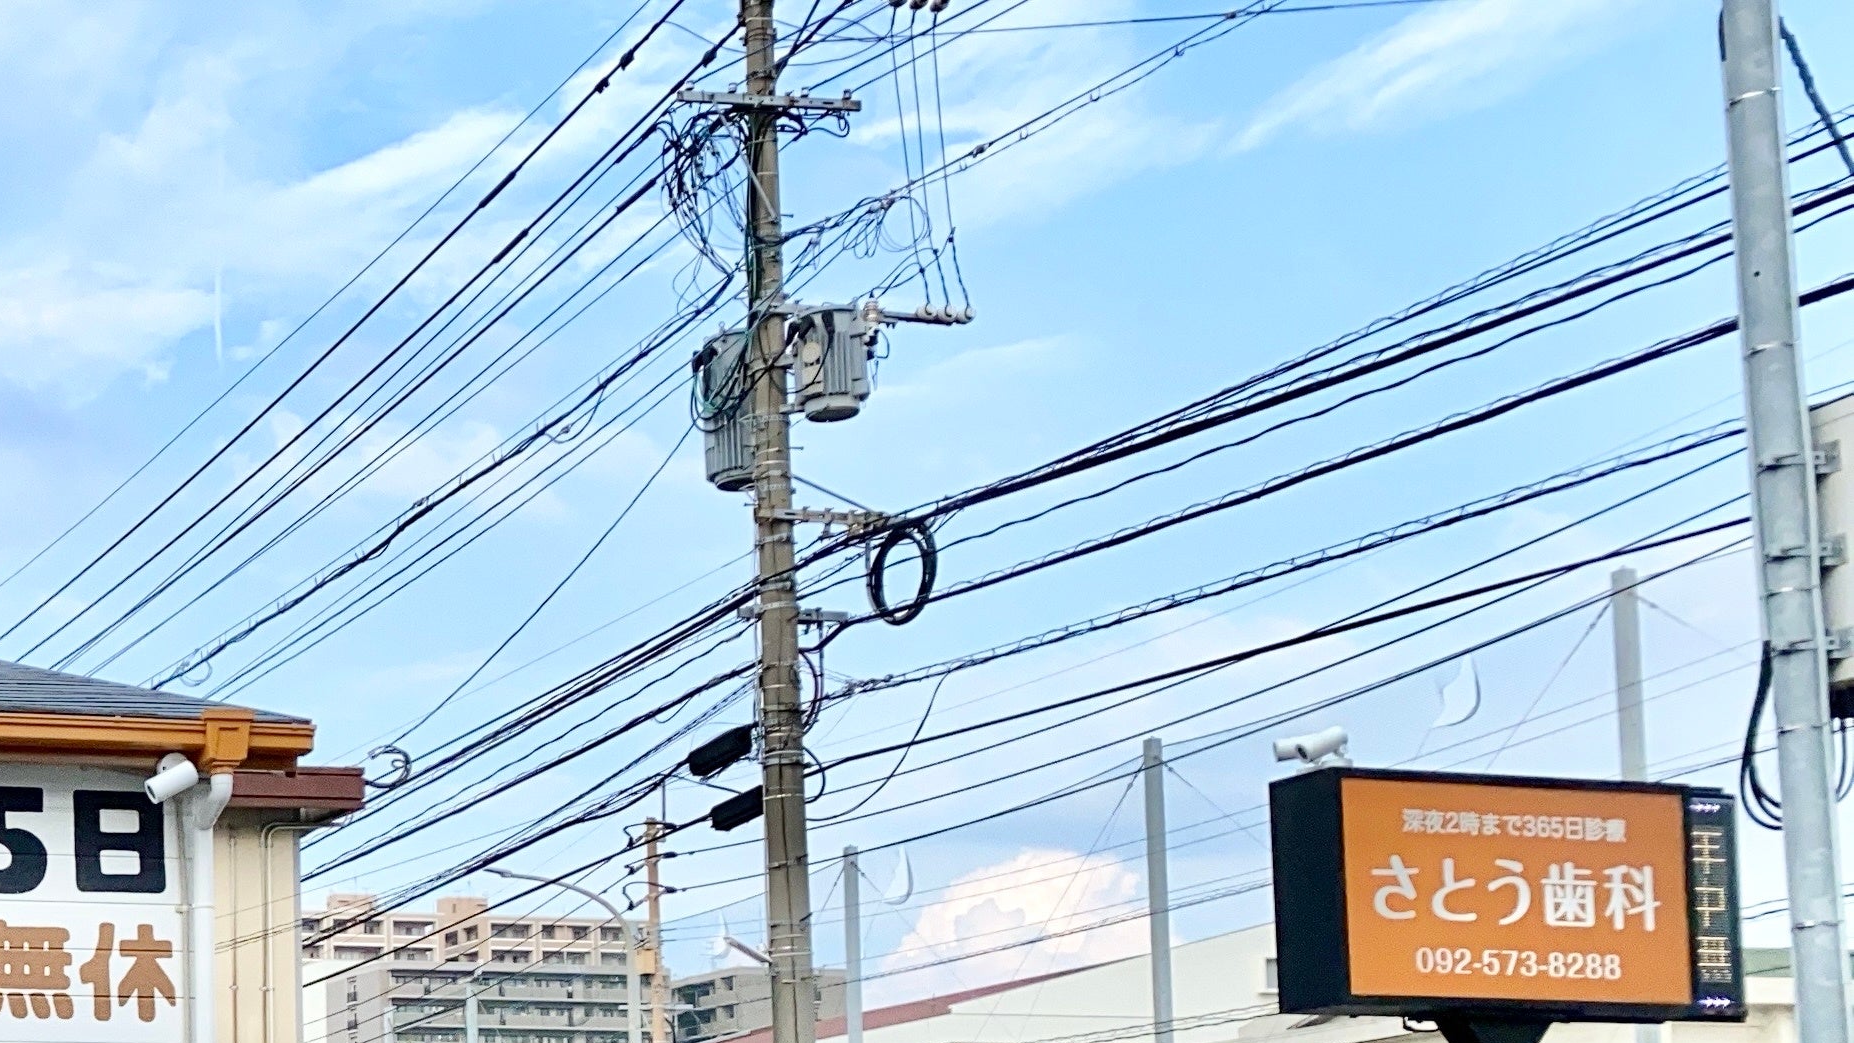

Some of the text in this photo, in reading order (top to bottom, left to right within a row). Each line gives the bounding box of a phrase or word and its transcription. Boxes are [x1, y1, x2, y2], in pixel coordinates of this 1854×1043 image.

[1371, 854, 1661, 931] さとう歯科
[1415, 946, 1622, 981] 092-573-8288
